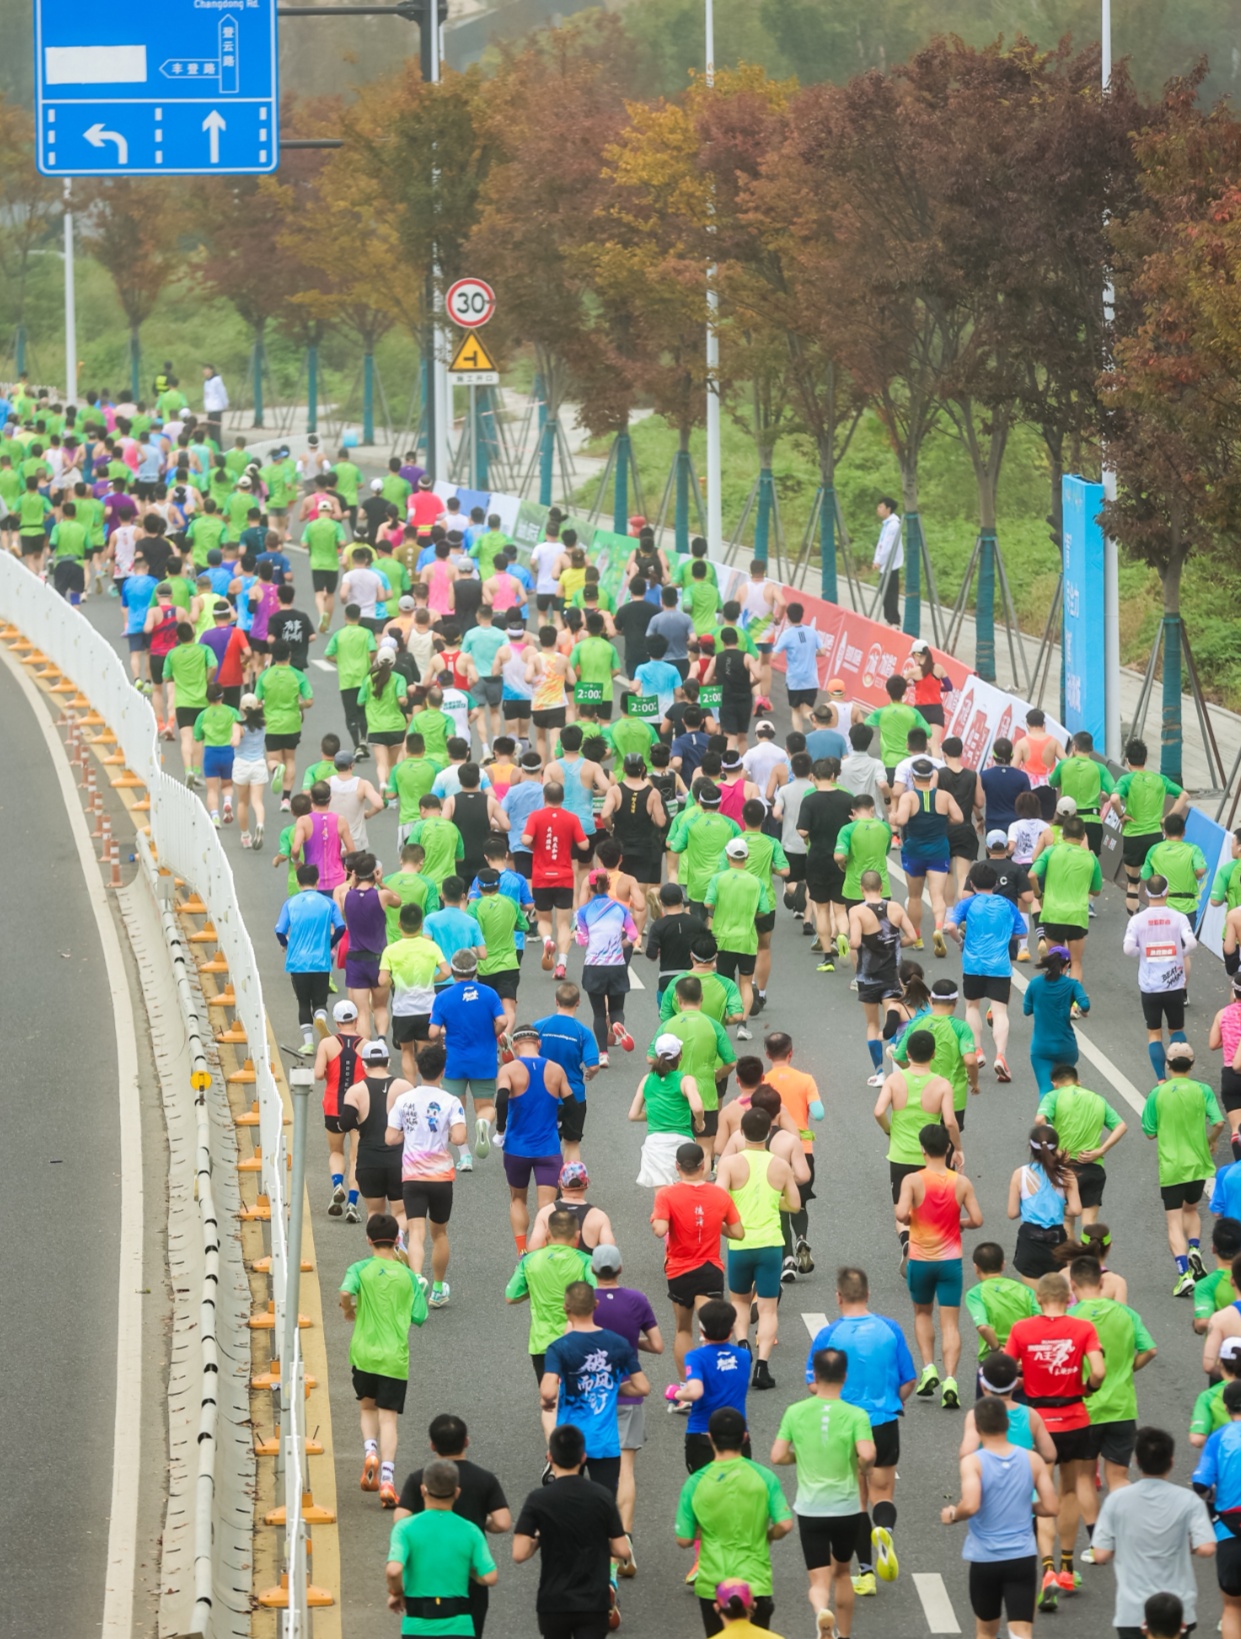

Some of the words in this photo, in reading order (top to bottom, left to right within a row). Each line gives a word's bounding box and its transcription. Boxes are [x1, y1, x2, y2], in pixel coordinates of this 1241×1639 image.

[194, 0, 243, 10] Changdong
[222, 26, 234, 67] 登云路
[172, 63, 215, 75] 丰登路
[457, 292, 485, 313] 30
[577, 689, 599, 699] 2:00
[631, 702, 654, 712] 2:00
